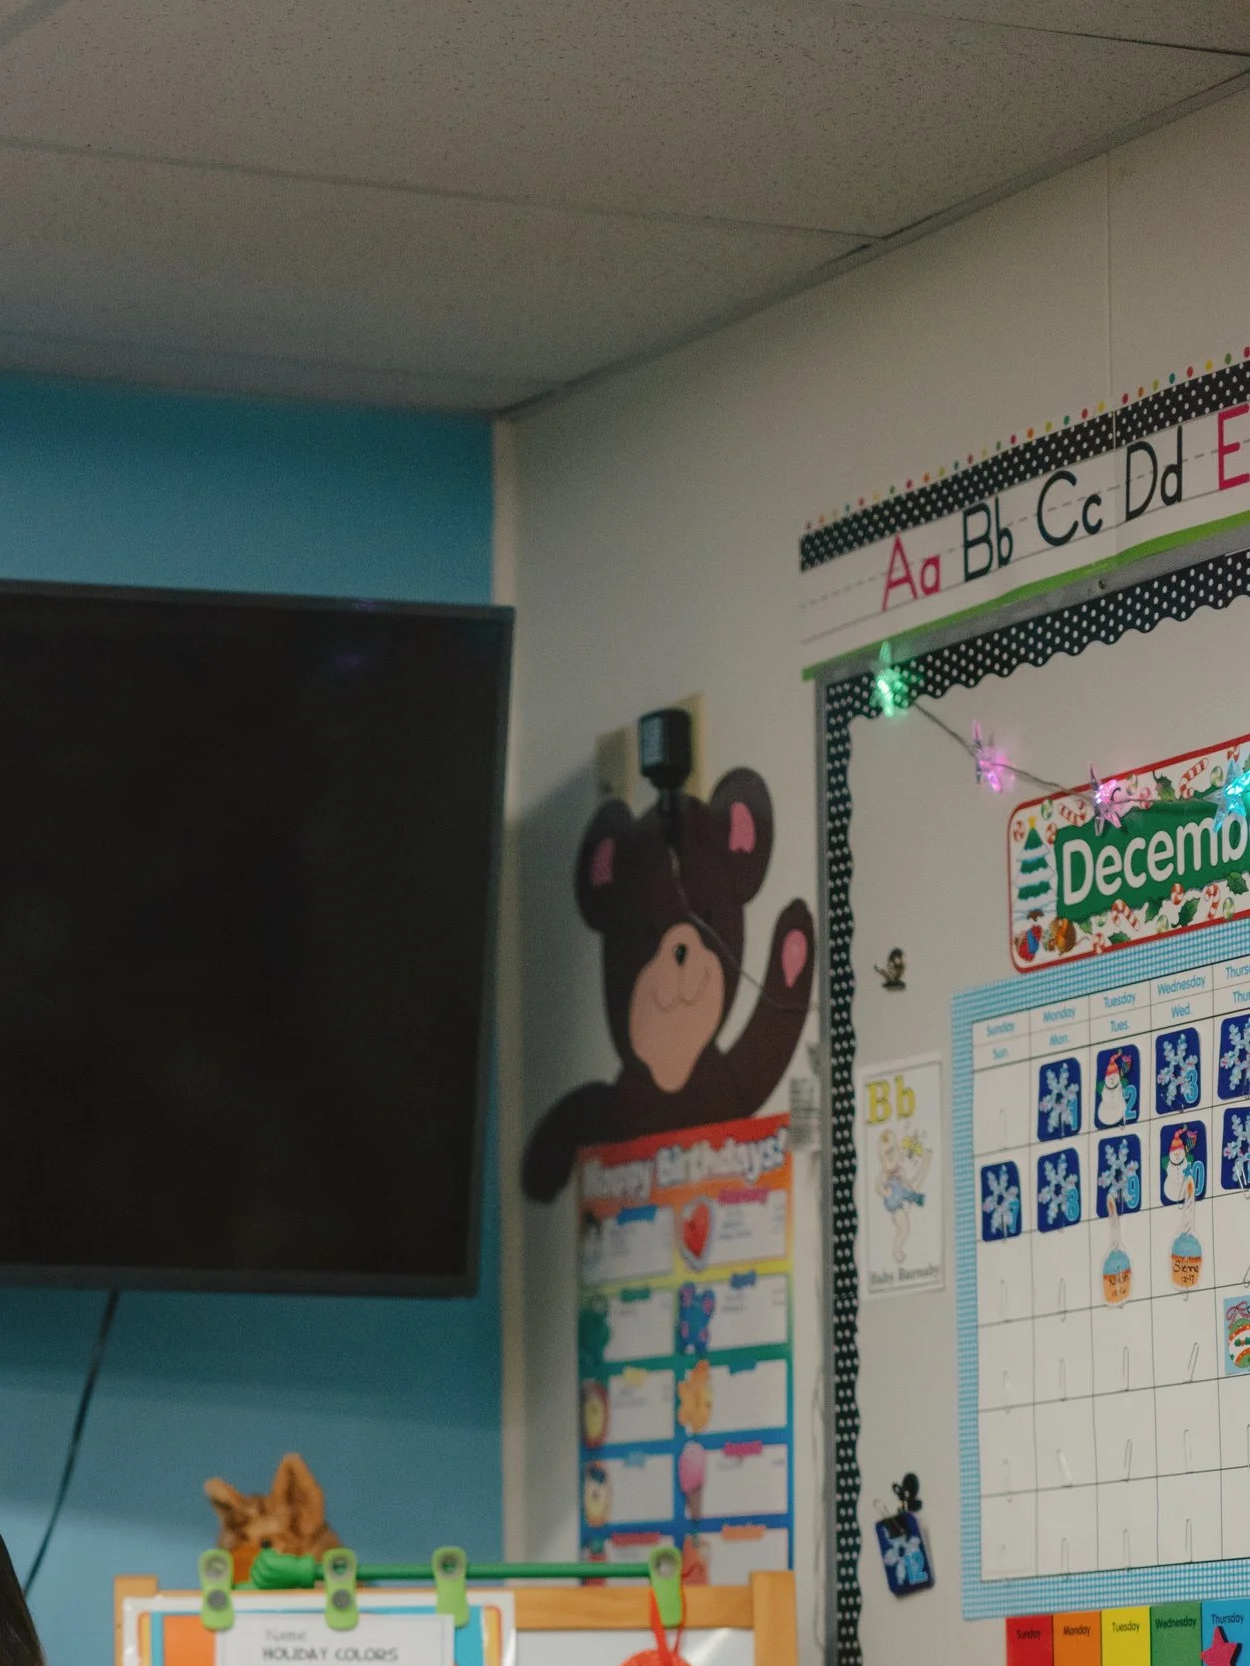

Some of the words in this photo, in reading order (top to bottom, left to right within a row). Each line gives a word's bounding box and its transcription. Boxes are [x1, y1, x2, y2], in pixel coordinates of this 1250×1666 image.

[882, 534, 941, 611] Aa
[962, 495, 1013, 582] Bb
[1037, 470, 1103, 546] Cc
[1125, 425, 1183, 522] Dd
[1226, 965, 1250, 979] Thurs
[1157, 975, 1206, 996] Wednesday
[1103, 992, 1136, 1009] Tuesday
[1043, 1005, 1076, 1022] Monday
[1171, 1003, 1193, 1018] Wed.
[986, 1020, 1015, 1035] Sunday
[1185, 1068, 1198, 1104] 3
[866, 1074, 916, 1125] Bb
[1123, 1085, 1137, 1120] 2
[1126, 1174, 1140, 1208] 9
[1065, 1187, 1079, 1222] 8
[1112, 1621, 1140, 1633] Tuesday
[1155, 1616, 1196, 1630] Wednesday
[1211, 1613, 1244, 1625] Thursday
[1017, 1629, 1040, 1640] Sunday
[1063, 1625, 1091, 1637] Monday
[263, 1647, 328, 1661] HOLIDAY
[335, 1648, 398, 1661] COLORS
